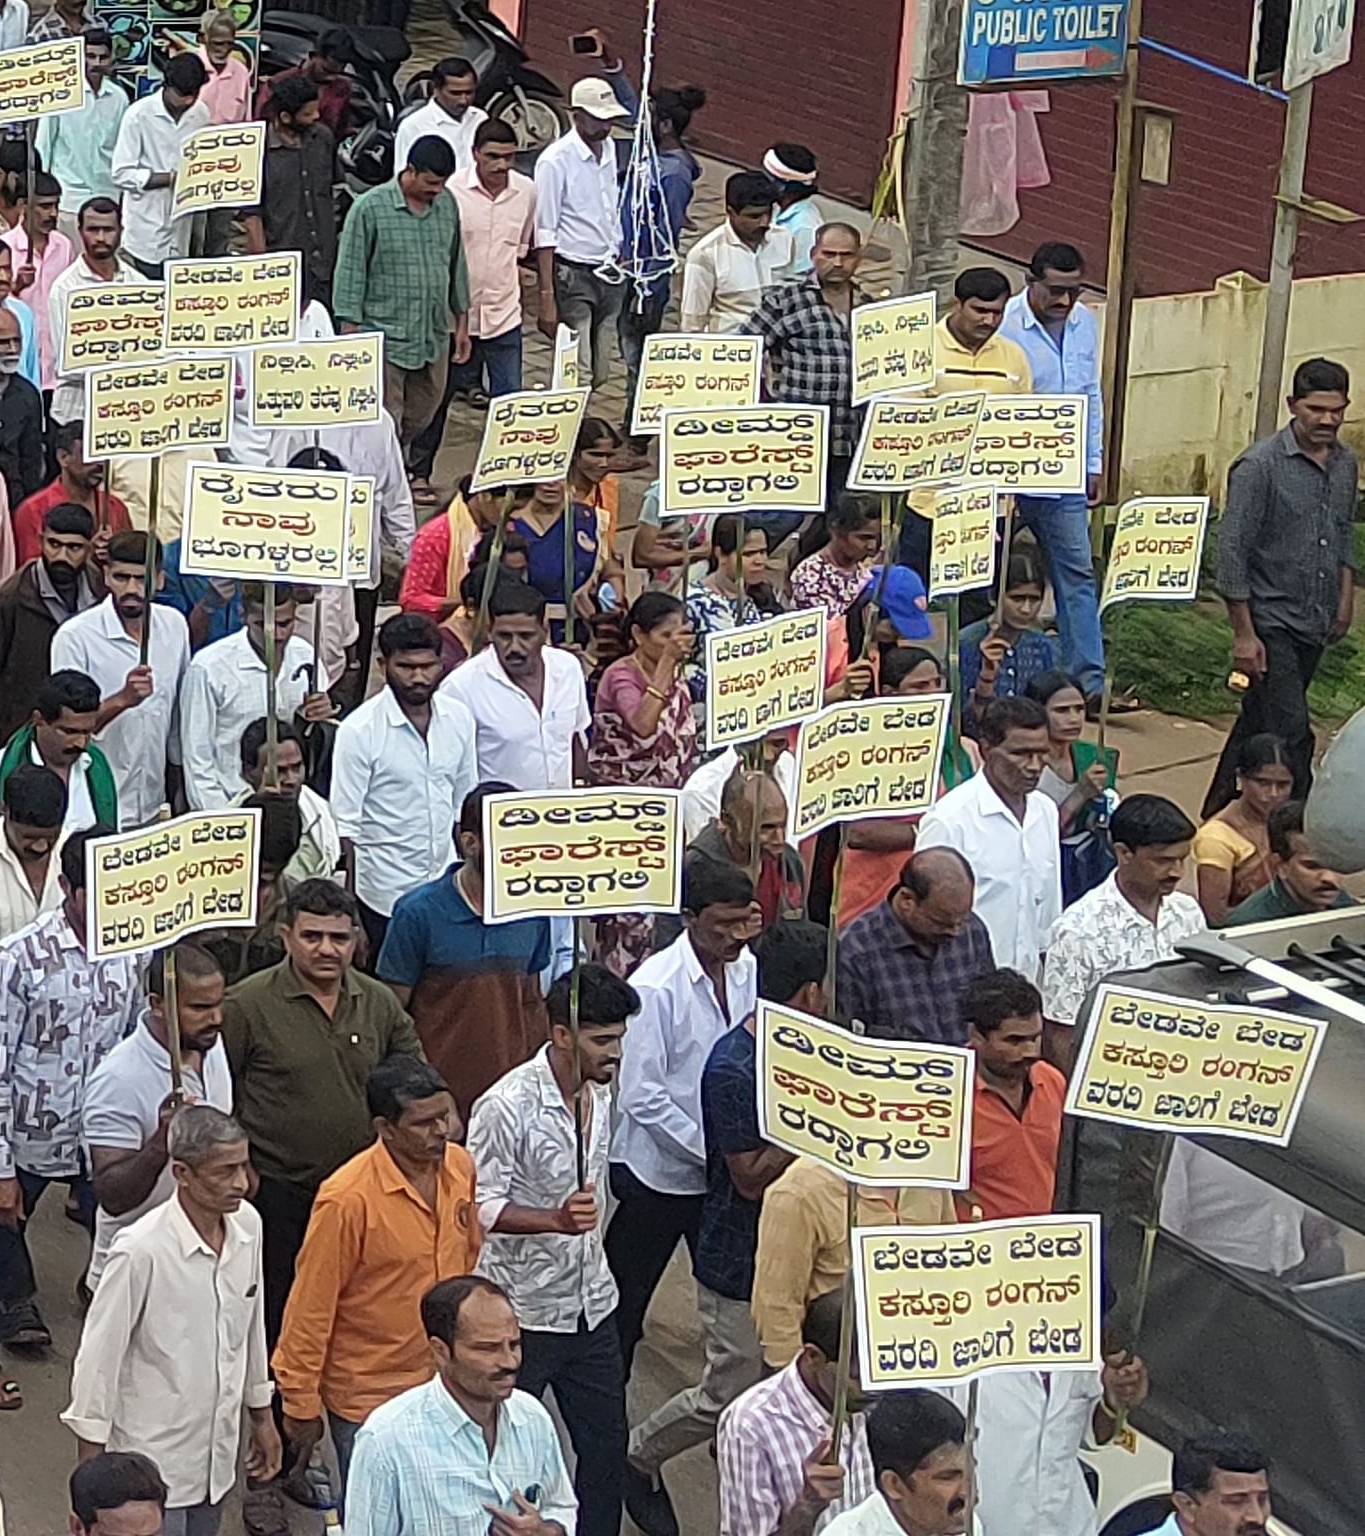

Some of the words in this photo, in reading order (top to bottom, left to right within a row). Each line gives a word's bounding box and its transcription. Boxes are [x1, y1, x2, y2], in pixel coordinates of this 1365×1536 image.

[972, 8, 1048, 46] PUBLIC
[1052, 3, 1123, 42] TOILET
[672, 413, 814, 442] ಡೀಮ್ಡ್
[672, 442, 814, 474] ಫಾರೆಸ್ಟ್
[198, 472, 338, 505] ರೈತರು
[676, 471, 799, 503] ರದ್ದಾಗಲಿ
[221, 509, 316, 537] ನಾವು
[190, 536, 338, 572] ಭೂಗಳ್ಳರಲ್ಲ
[497, 799, 666, 832] ಡೀಮ್ಡ್
[101, 832, 181, 871] ಬೇಡವೇ
[191, 819, 247, 844] ಬೇಡ
[499, 834, 666, 869] ಫಾರೆಸ್ಟ್
[103, 873, 168, 906] ಕಸ್ತೂರಿ
[175, 851, 244, 885] ರಂಗನ್
[504, 867, 649, 905] ರದ್ದಾಗಲಿ
[101, 916, 145, 947] ವರದಿ
[153, 891, 194, 935] ಜಾರಿಗೆ
[201, 886, 244, 915] ಬೇಡ
[1109, 1001, 1220, 1040] ಬೇಡವೇ
[1235, 1020, 1307, 1052] ಬೇಡ
[771, 1025, 954, 1096] ಡೀಮ್ಡ್
[1101, 1040, 1188, 1080] ಕಸ್ತೂರಿ
[1201, 1054, 1294, 1085] ರಂಗನ್
[771, 1064, 952, 1138] ಫಾರೆಸ್ಟ್
[1085, 1076, 1143, 1111] ವರದಿ
[1153, 1089, 1221, 1120] ಜಾರಿಗೆ
[1227, 1093, 1283, 1128] ಬೇಡ
[777, 1102, 930, 1160] ರದ್ದಾಗಲಿ
[872, 1238, 991, 1271] ಬೇಡವೇ
[1009, 1230, 1082, 1259] ಬೇಡ
[877, 1287, 971, 1326] ಕಸ್ತೂರಿ
[985, 1273, 1080, 1307] ರಂಗನ್
[876, 1336, 938, 1371] ವರದಿ
[952, 1319, 1014, 1368] ಜಾರಿಗೆ
[1027, 1318, 1082, 1354] ಬೇಡ
